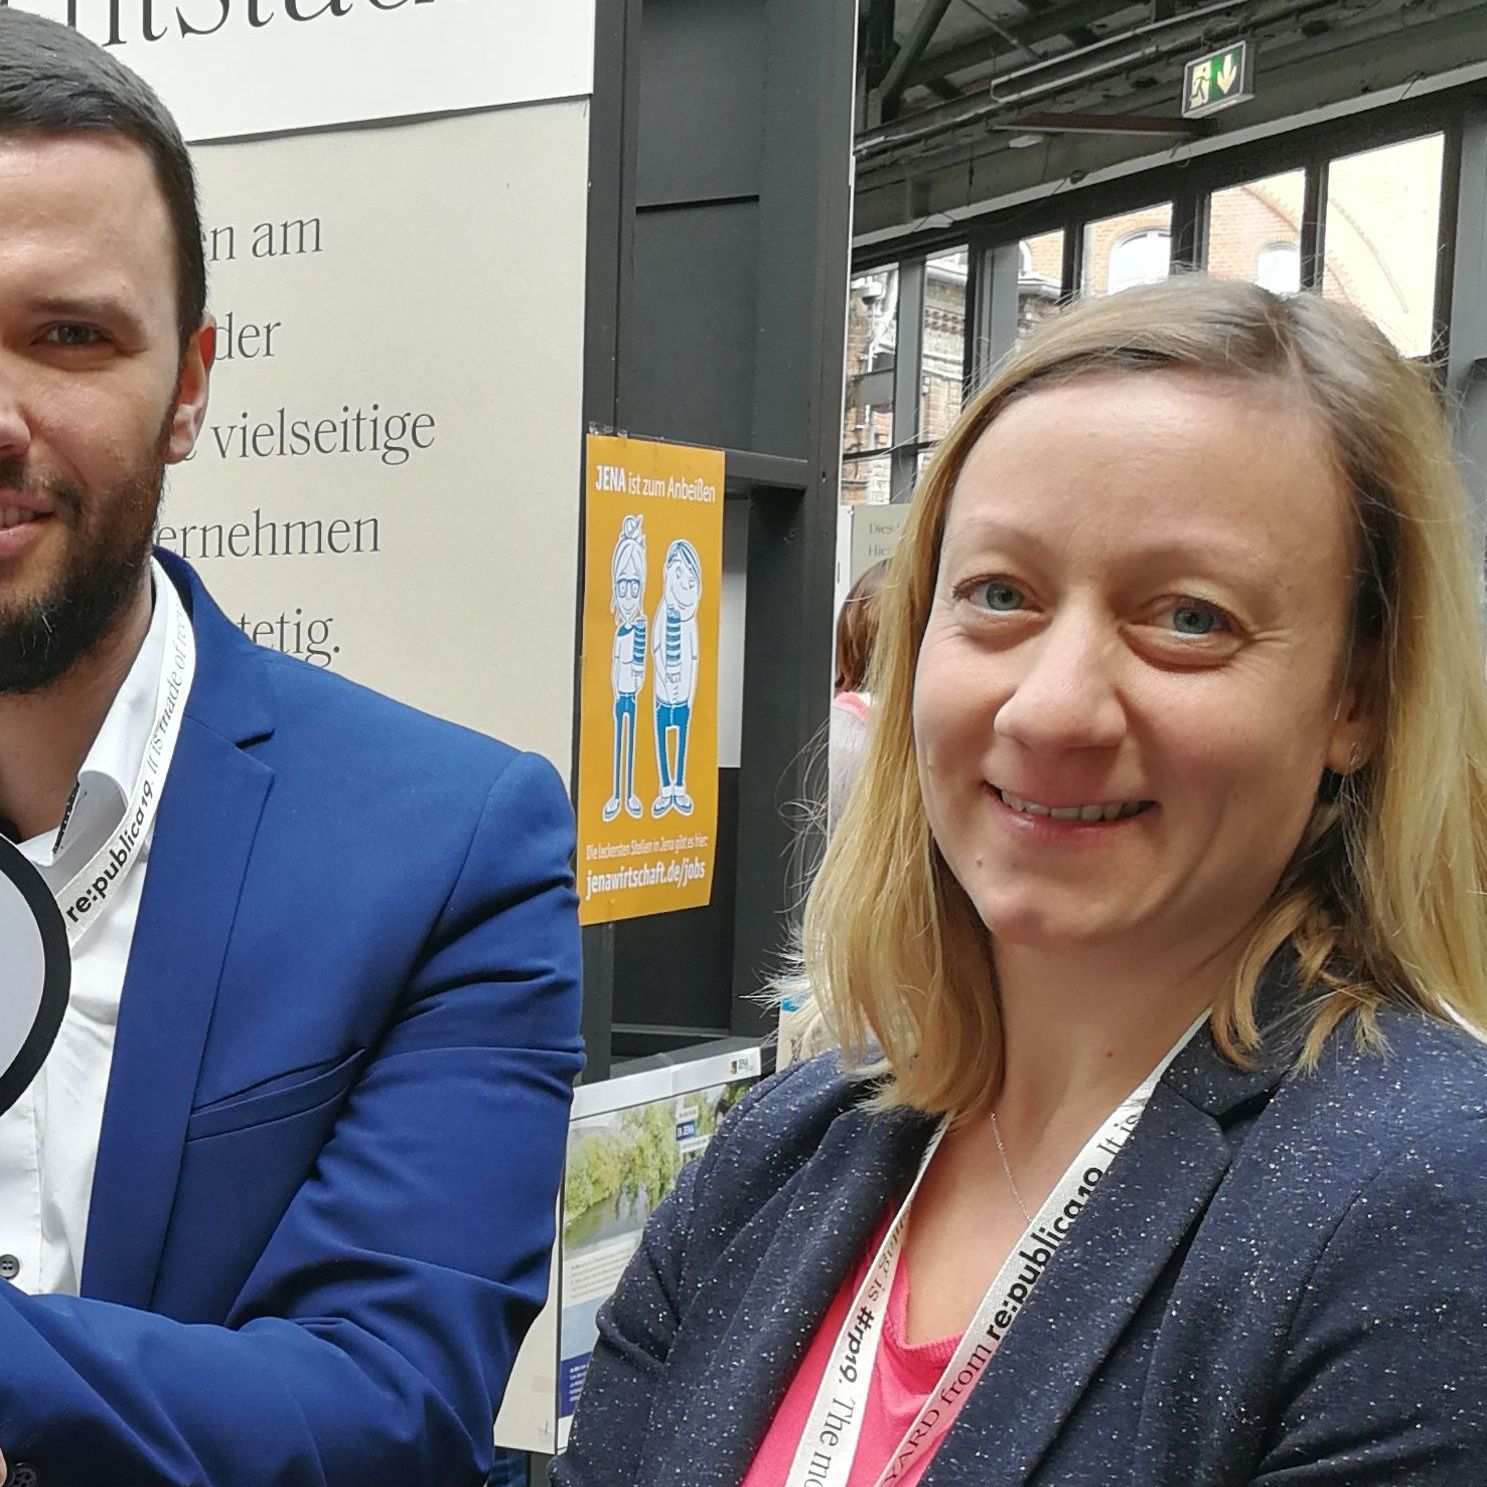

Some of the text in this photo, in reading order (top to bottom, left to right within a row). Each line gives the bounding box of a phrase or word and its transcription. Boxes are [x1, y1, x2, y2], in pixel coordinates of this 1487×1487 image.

[252, 217, 324, 258] am
[210, 404, 436, 466] vielseitige
[595, 465, 716, 503] JENA ist zum Anbeißen
[159, 670, 183, 736] made
[585, 856, 706, 902] jenawirtschaft.de/jobs
[838, 1305, 875, 1384] #rp19.
[940, 1344, 992, 1406] from
[818, 1397, 856, 1447] The
